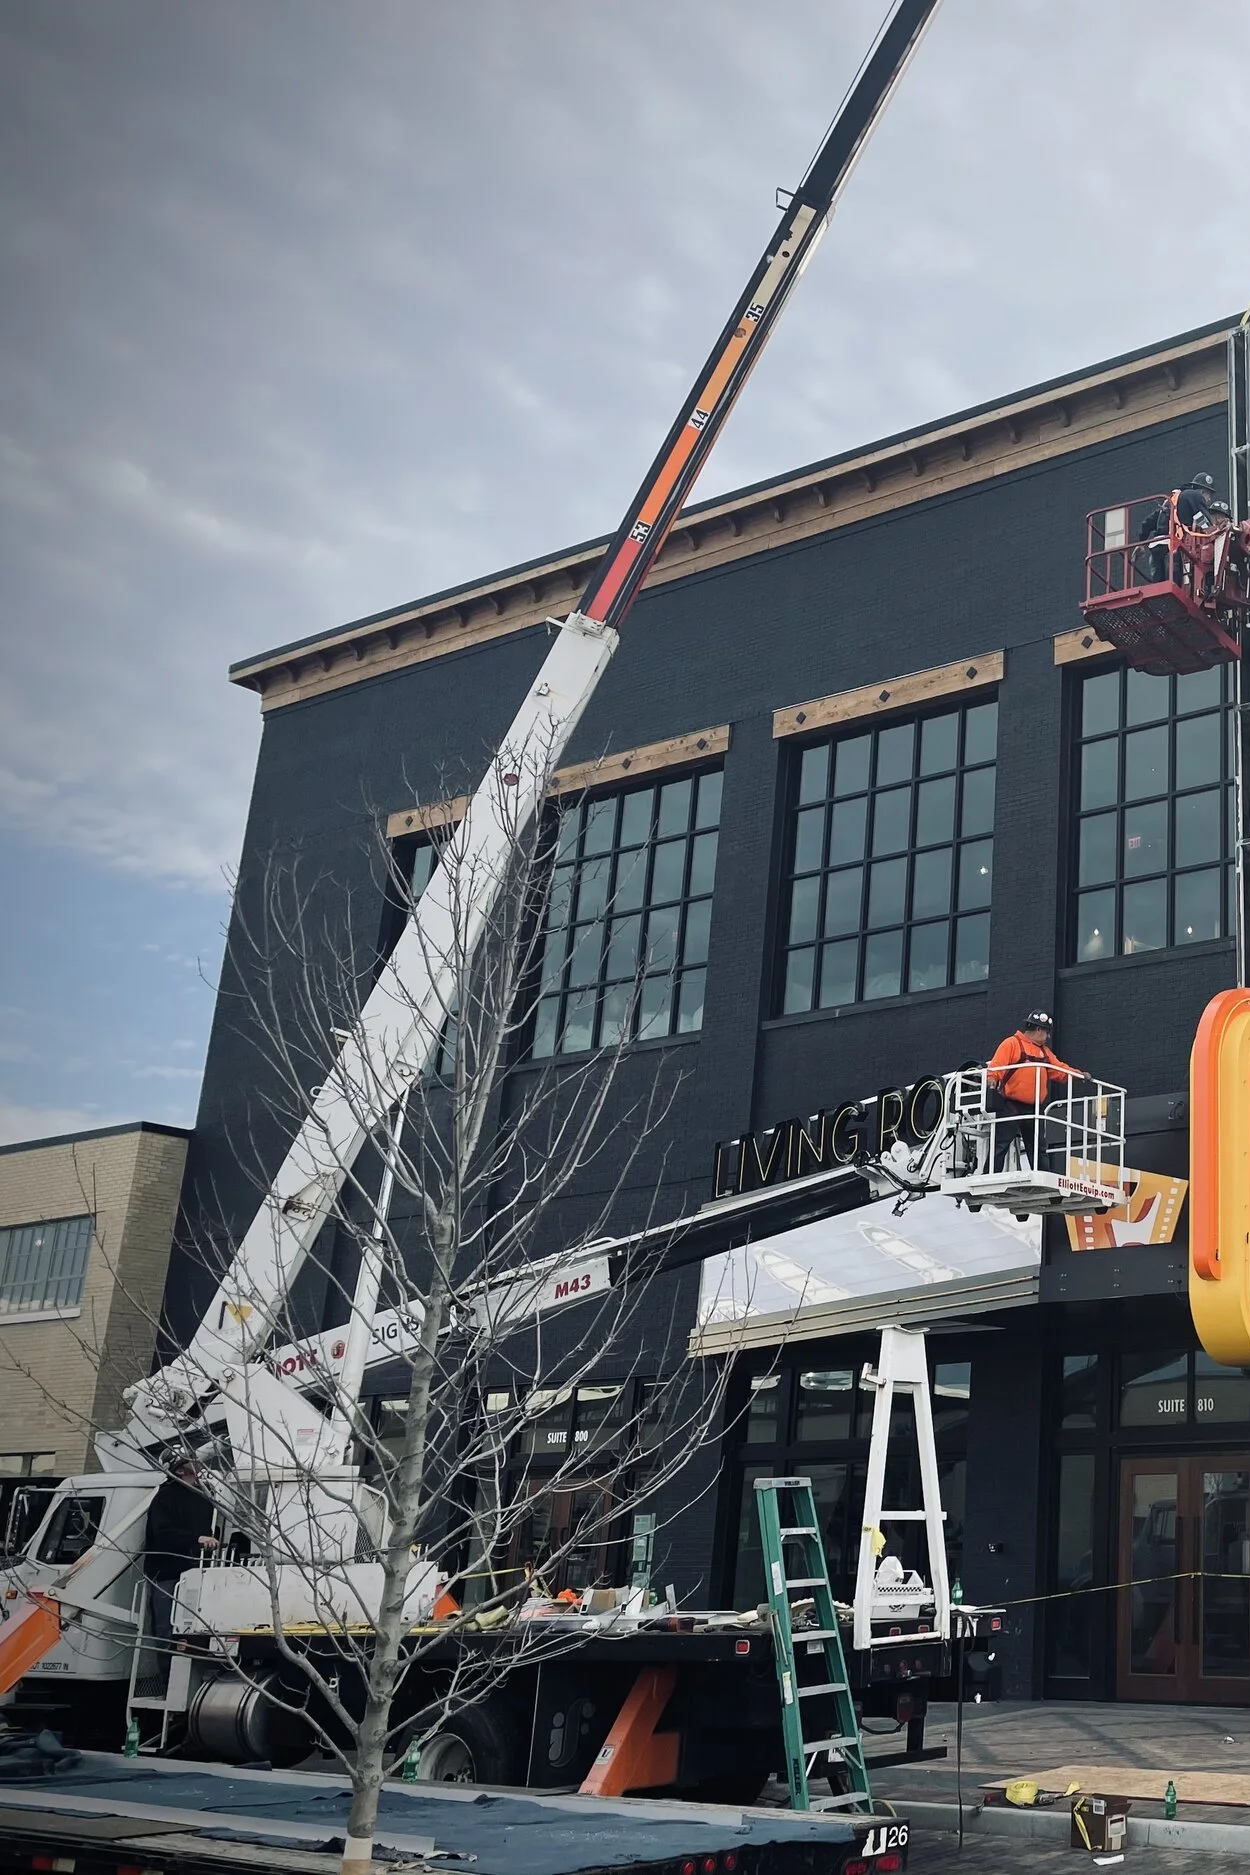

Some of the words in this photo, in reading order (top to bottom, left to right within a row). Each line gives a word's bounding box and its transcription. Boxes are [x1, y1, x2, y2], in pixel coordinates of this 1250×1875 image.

[746, 302, 765, 322] 35
[691, 410, 709, 429] 44
[631, 522, 650, 542] 53
[711, 1100, 868, 1201] LIVING
[1058, 1178, 1115, 1200] ElliottEquip.com
[554, 1273, 592, 1300] M43
[1158, 1399, 1185, 1412] SUITE
[1197, 1398, 1214, 1412] 810
[547, 1431, 567, 1443] SUITE
[574, 1430, 588, 1443] 800
[888, 1825, 908, 1847] 26
